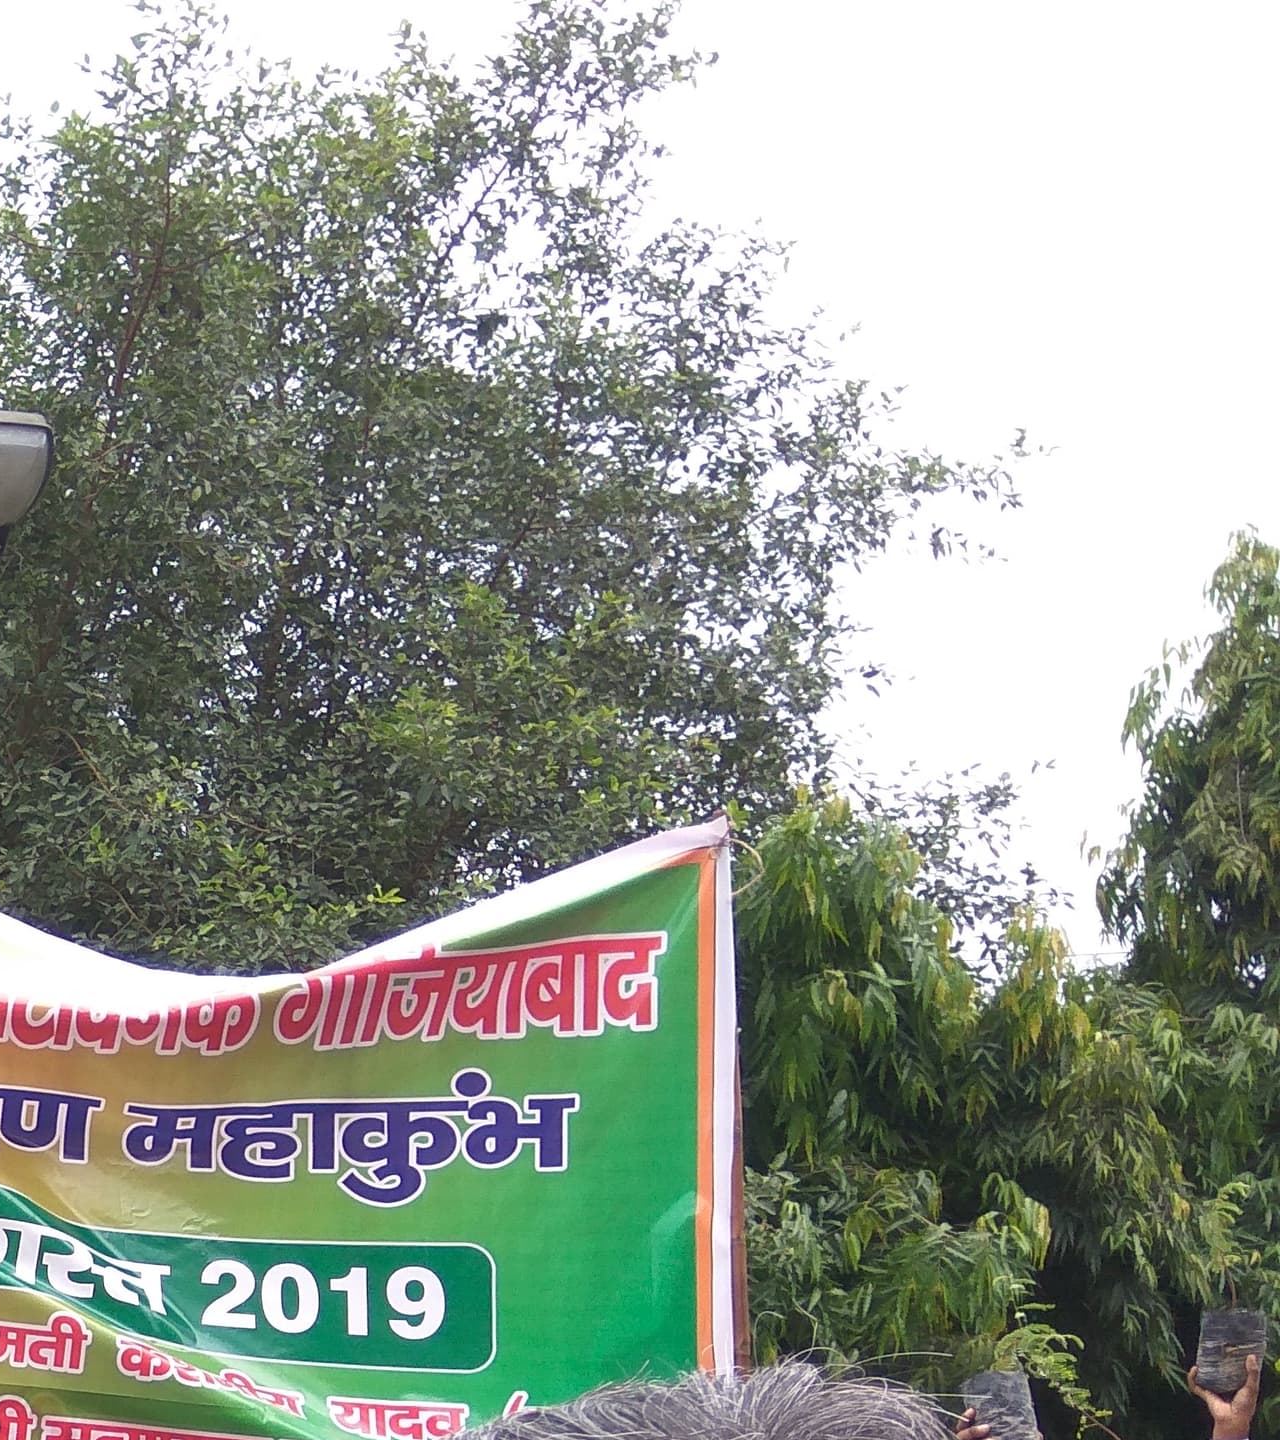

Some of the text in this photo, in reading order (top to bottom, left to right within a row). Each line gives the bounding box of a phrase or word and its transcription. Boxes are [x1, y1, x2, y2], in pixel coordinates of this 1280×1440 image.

[124, 1070, 577, 1205] महाकुंभ
[199, 1258, 446, 1340] 2019
[330, 1400, 466, 1440] यादव
